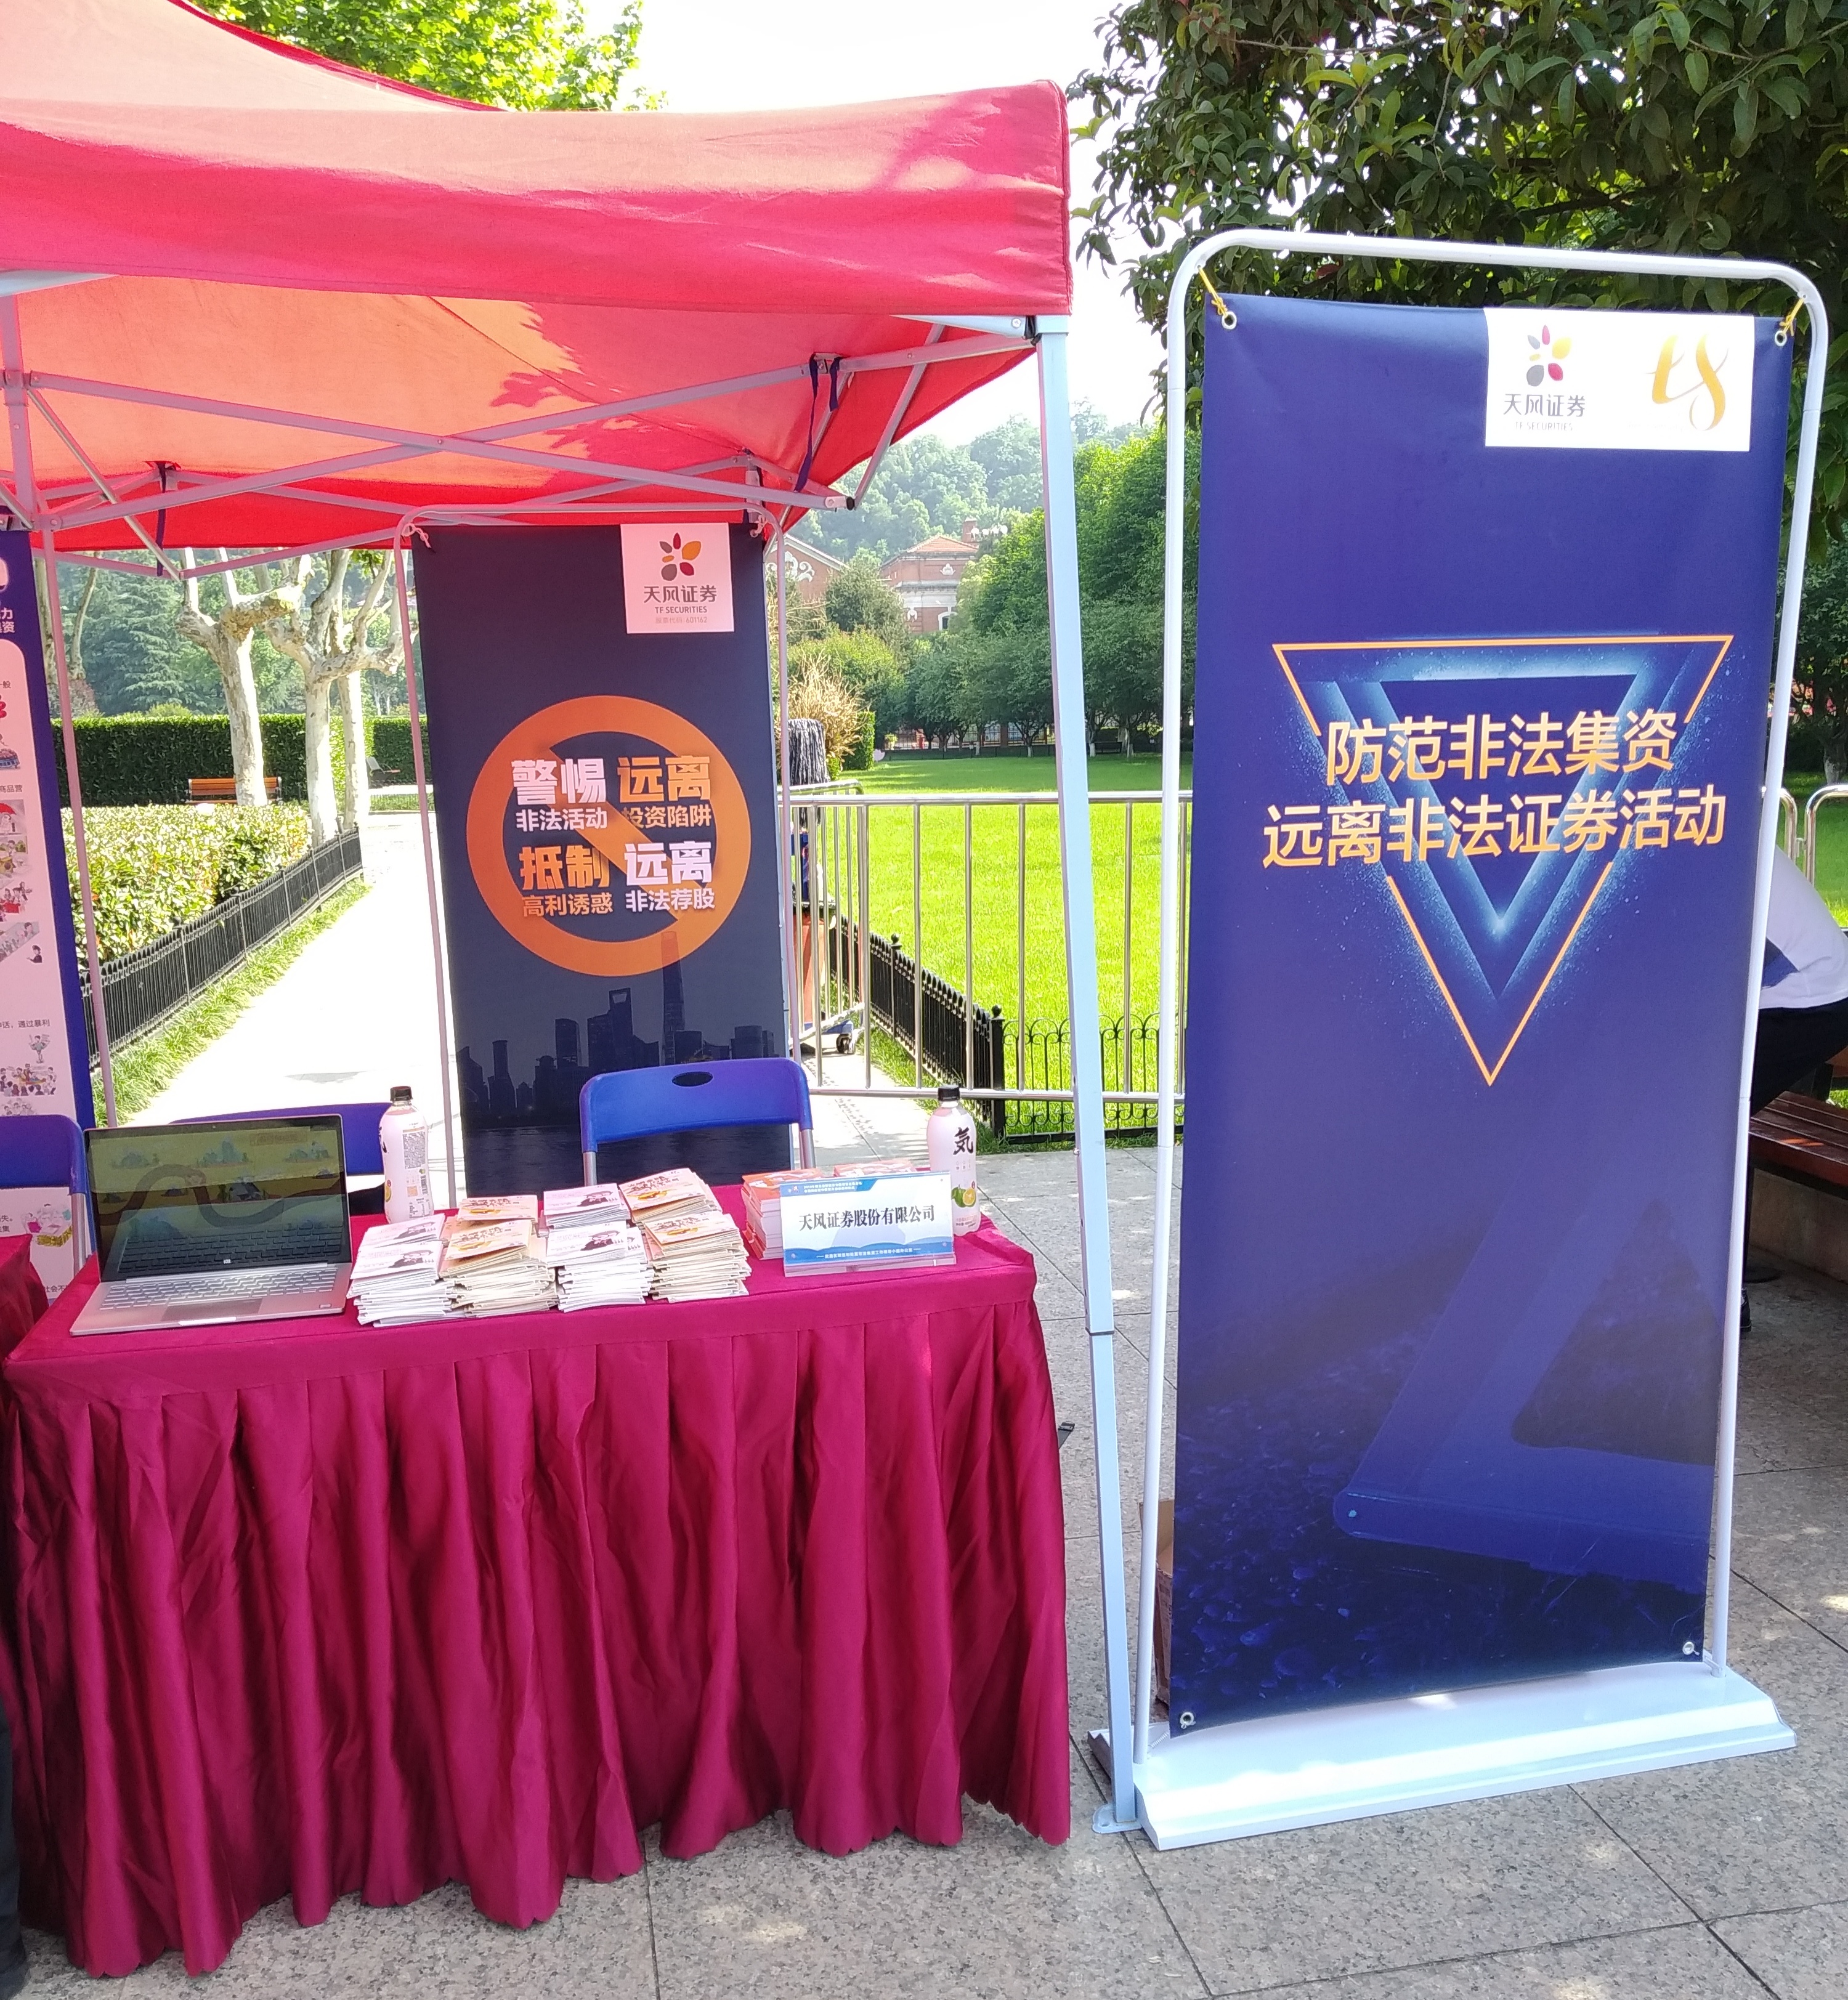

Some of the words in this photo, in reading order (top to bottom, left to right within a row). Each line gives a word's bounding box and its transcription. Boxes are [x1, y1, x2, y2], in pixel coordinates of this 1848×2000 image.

[1503, 393, 1586, 418] 天风证券
[1526, 421, 1573, 431] SECURITIES
[643, 585, 717, 604] 天风证券
[655, 606, 664, 614] TF
[665, 605, 708, 614] SECURITIES
[0, 621, 15, 633] 资
[1326, 707, 1677, 786] 防范非法集资
[511, 758, 607, 806] 警惕
[617, 755, 711, 803] 远离
[516, 807, 608, 832] 非法活动
[622, 804, 711, 829] 投资陷阱
[1262, 783, 1727, 868] 远离非法证券活动
[519, 844, 610, 891] 抵制
[624, 840, 712, 886] 远离
[522, 892, 614, 918] 高利诱惑
[625, 888, 716, 913] 非法荐股
[0, 1019, 50, 1029] 话，通过暴利
[799, 1204, 935, 1231] 天风证券股份有限公司
